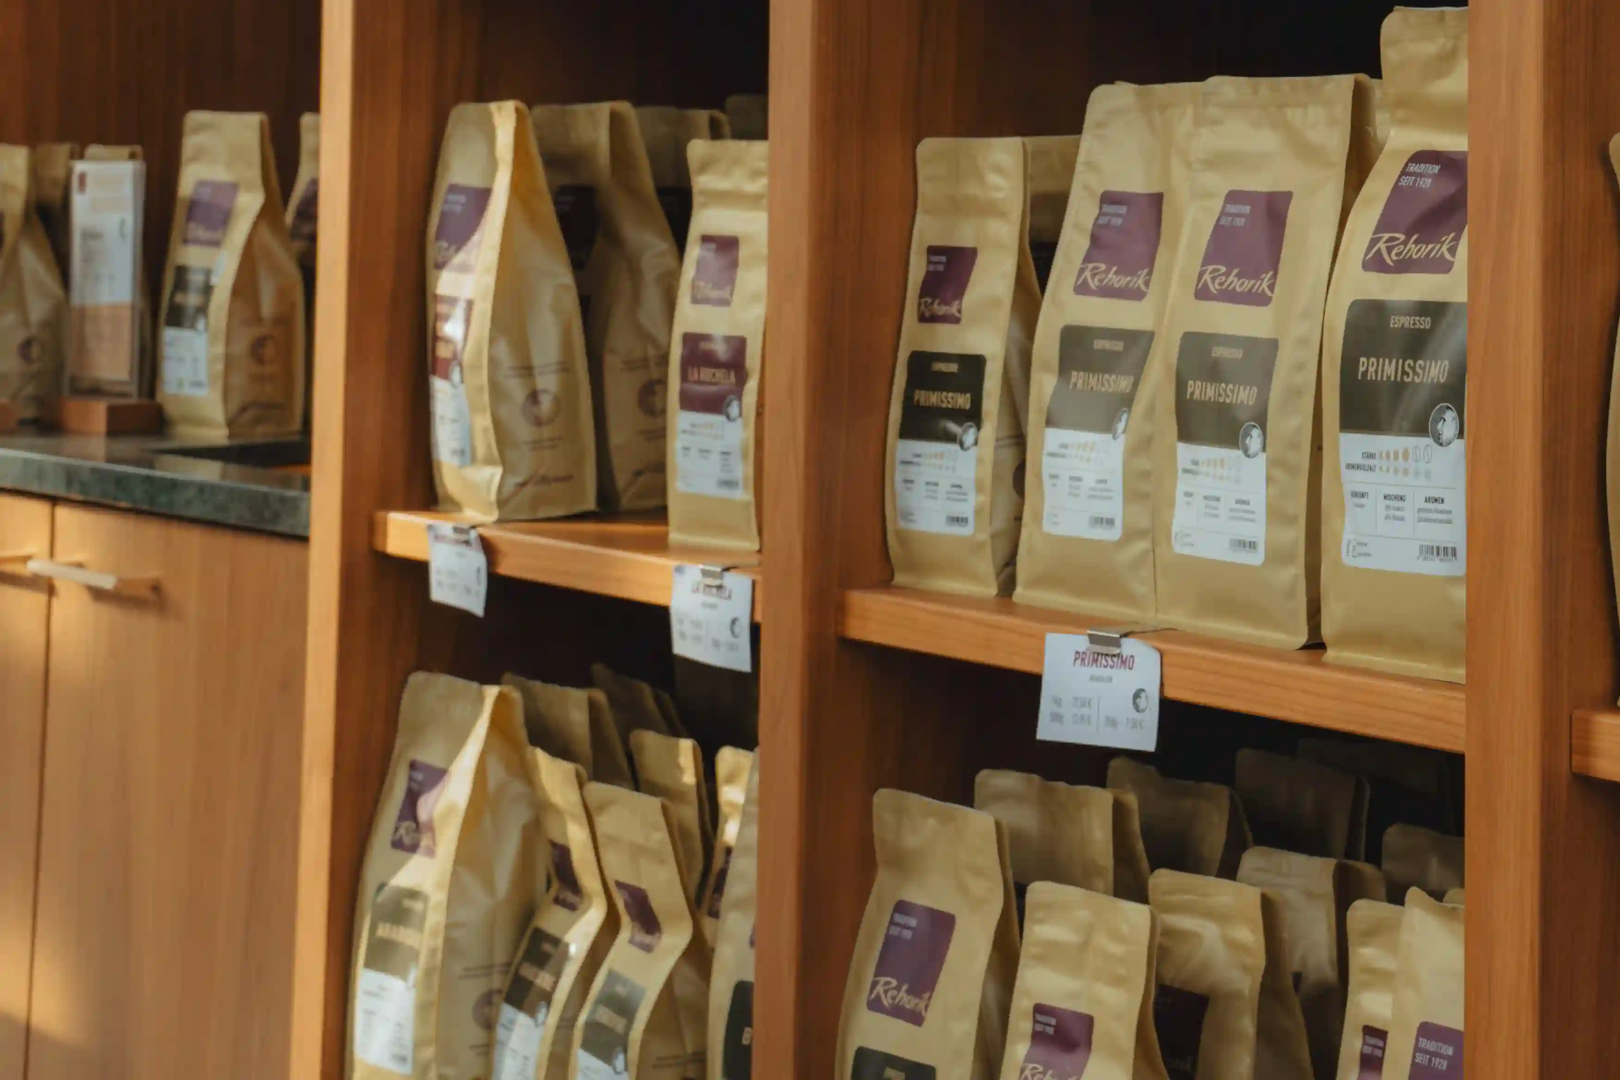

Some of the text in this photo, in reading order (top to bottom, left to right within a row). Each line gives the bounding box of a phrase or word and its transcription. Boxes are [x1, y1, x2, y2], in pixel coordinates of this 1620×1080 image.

[1406, 162, 1441, 175] TRADITION
[1399, 176, 1415, 187] SEIT
[1365, 232, 1457, 266] Rehorik
[1198, 265, 1274, 297] Rehorik
[1390, 315, 1431, 329] ESPRESSO
[1358, 357, 1449, 384] PRIMISSIMO
[1069, 371, 1134, 394] PRIMISSIMO
[1187, 380, 1258, 406] PRIMISSIMO
[1424, 496, 1445, 505] AROMEN
[1073, 650, 1135, 670] PRIMISSIMO
